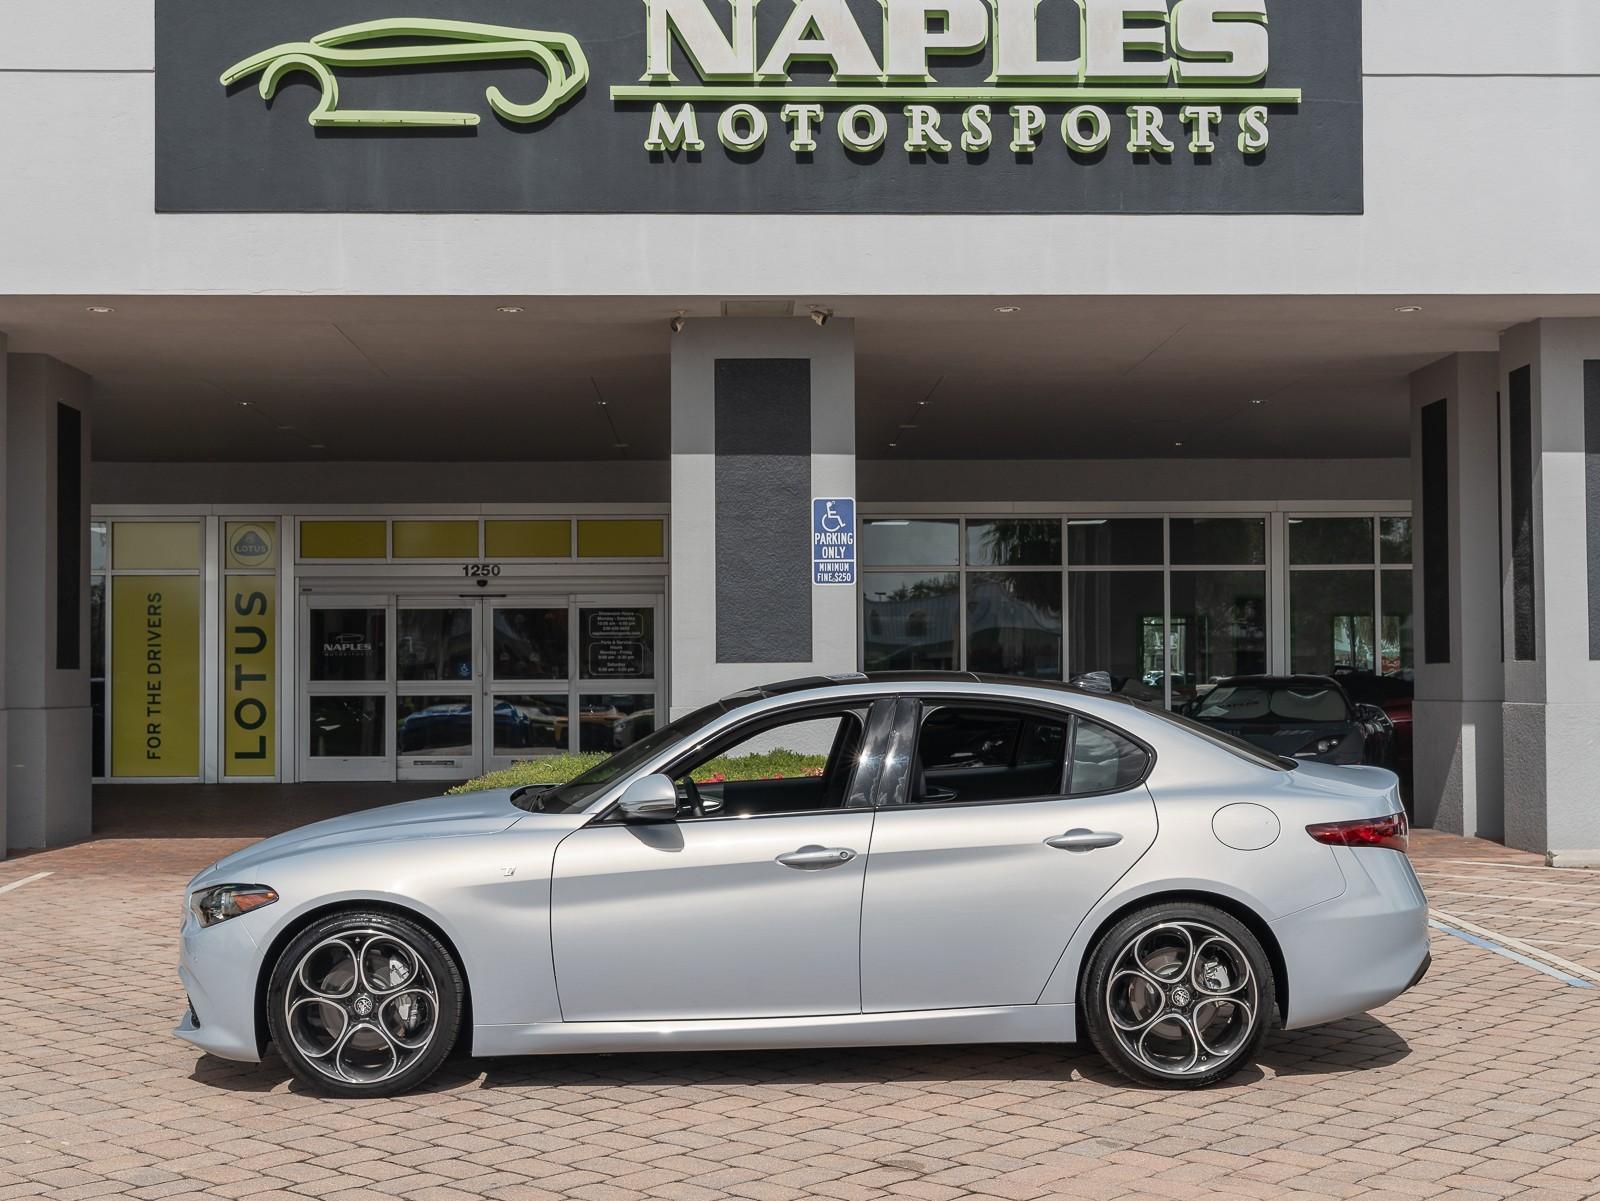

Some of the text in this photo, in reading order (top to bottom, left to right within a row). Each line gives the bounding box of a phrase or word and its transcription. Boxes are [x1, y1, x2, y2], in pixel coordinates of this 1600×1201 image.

[639, 0, 1270, 84] NAPLES
[643, 102, 1270, 155] MOTORSPORTS
[814, 532, 853, 545] PARKING
[235, 544, 267, 553] LOTUS
[821, 546, 846, 559] ONLY
[462, 564, 501, 577] 1250
[819, 562, 850, 572] MINIMUM
[834, 572, 851, 582] $250
[323, 643, 372, 651] NAPLES
[146, 591, 162, 760] FOR THE DRIVERS
[234, 590, 268, 760] LOTUS
